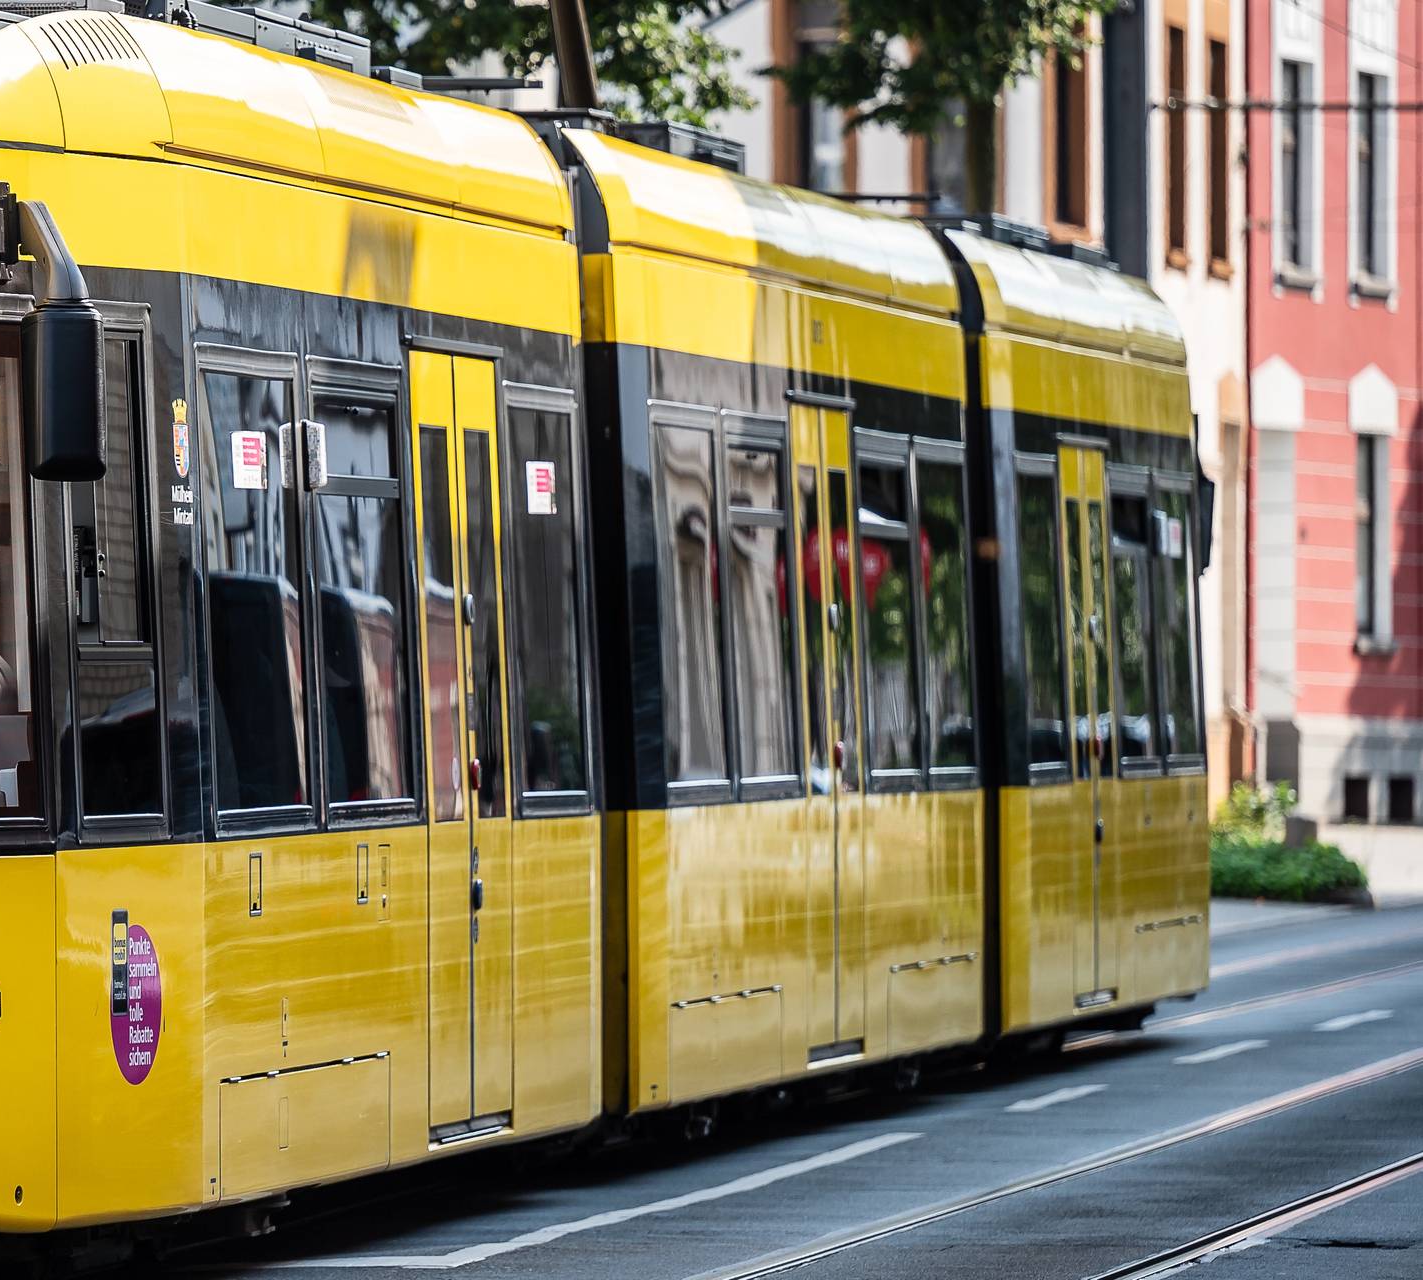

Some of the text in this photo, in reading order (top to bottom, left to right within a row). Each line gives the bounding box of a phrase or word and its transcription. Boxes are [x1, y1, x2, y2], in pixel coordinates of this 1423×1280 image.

[129, 936, 151, 956] Punkte
[129, 957, 157, 978] sammeln
[129, 979, 142, 1000] und
[129, 1002, 144, 1021] tolle
[129, 1025, 154, 1044] Rabatte
[129, 1048, 151, 1067] sichern
